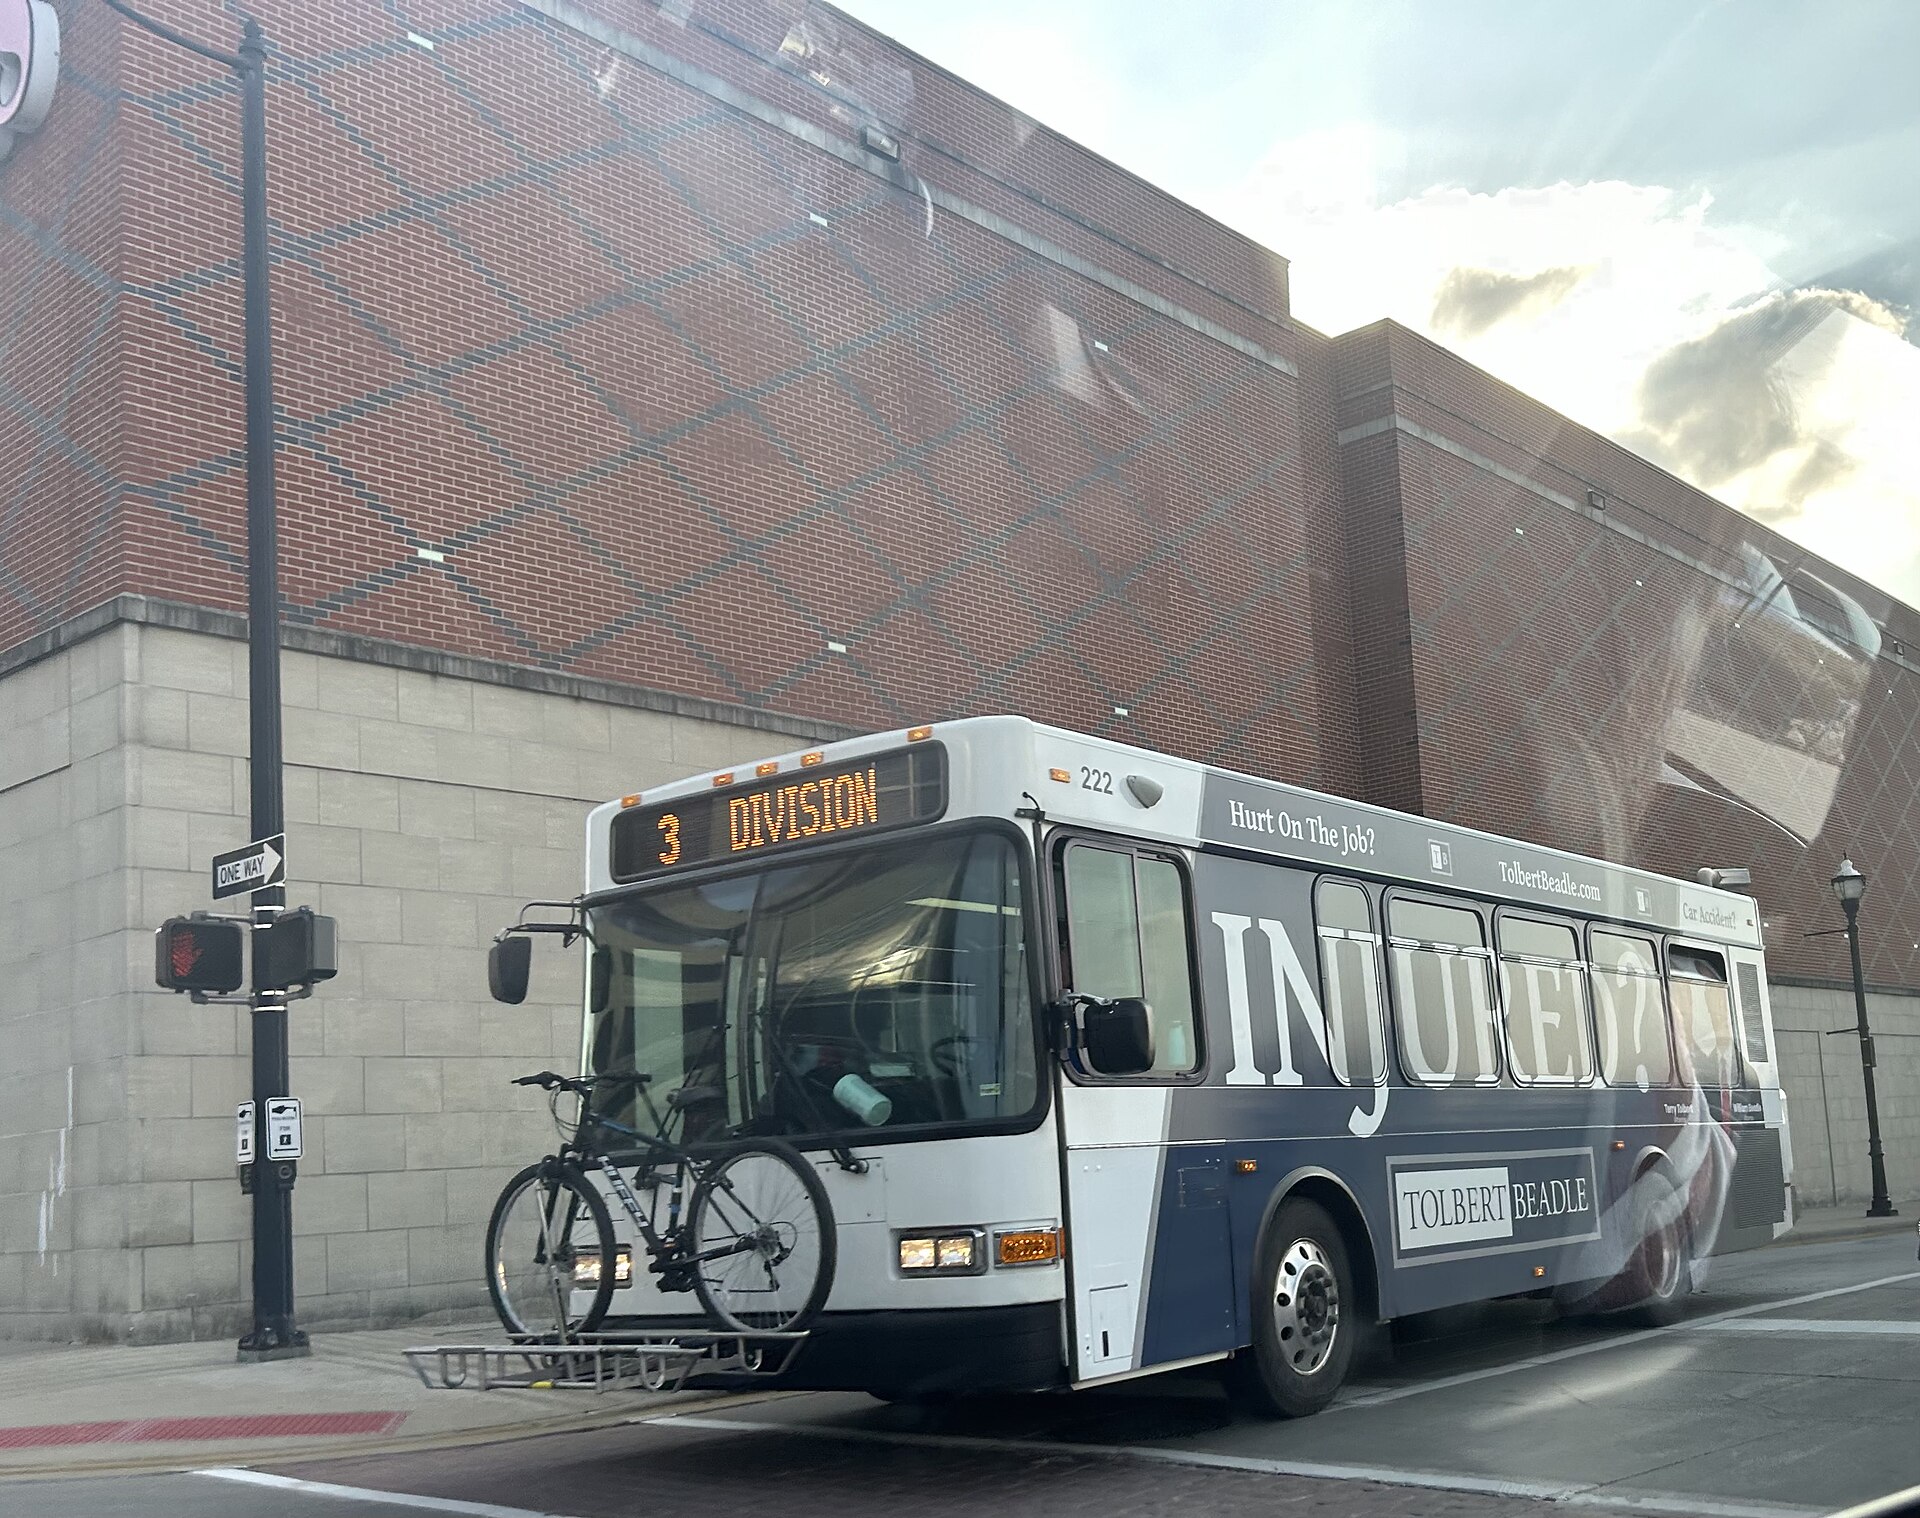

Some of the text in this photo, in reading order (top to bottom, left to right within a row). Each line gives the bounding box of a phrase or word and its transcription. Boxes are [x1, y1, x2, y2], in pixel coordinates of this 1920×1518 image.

[1081, 766, 1113, 795] 222
[657, 768, 878, 865] 3 DIVISION
[1228, 800, 1375, 856] Hurt On The Job?
[220, 856, 264, 884] ONE WAY
[1498, 860, 1601, 901] TolbertBeadle.com
[1683, 902, 1736, 930] Car Accident?
[1212, 911, 1650, 1138] INJURED?
[1403, 1177, 1589, 1230] TOLBERT BEADLE
